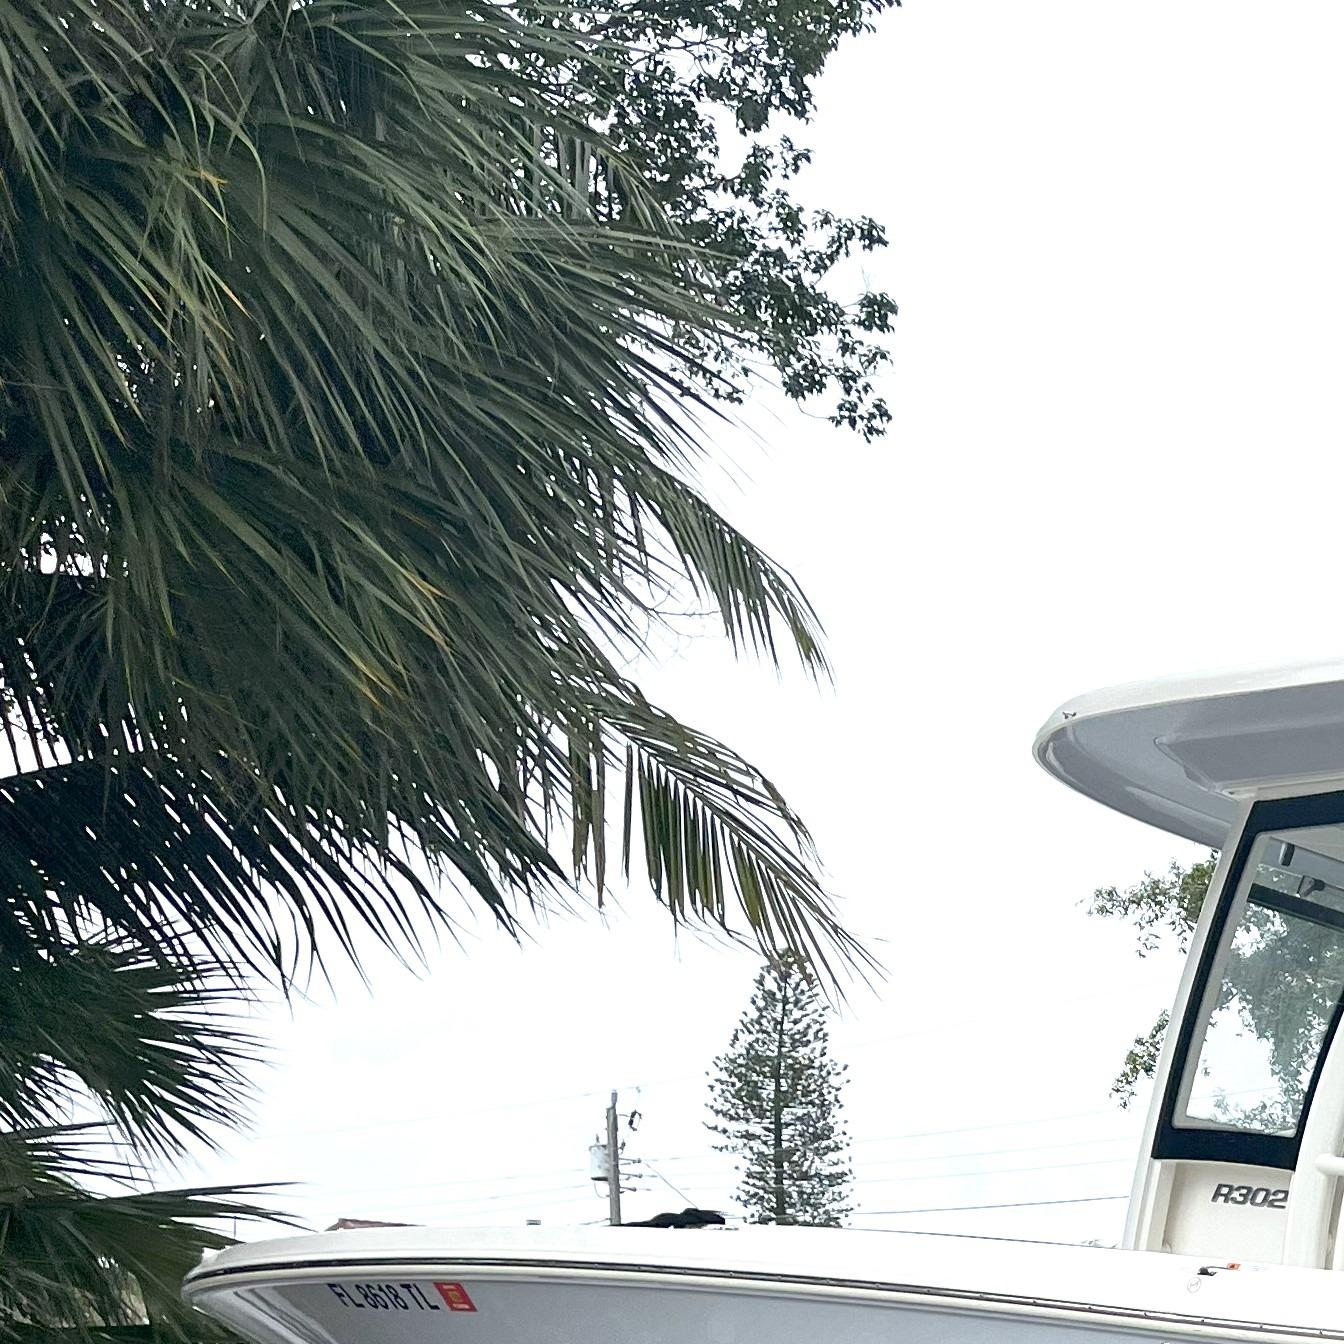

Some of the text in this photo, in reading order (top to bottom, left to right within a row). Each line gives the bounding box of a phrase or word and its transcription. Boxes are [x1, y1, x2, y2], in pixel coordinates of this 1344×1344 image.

[1210, 1183, 1289, 1209] R302
[327, 1283, 366, 1308] FL
[354, 1284, 409, 1310] 8618
[400, 1283, 440, 1310] TL
